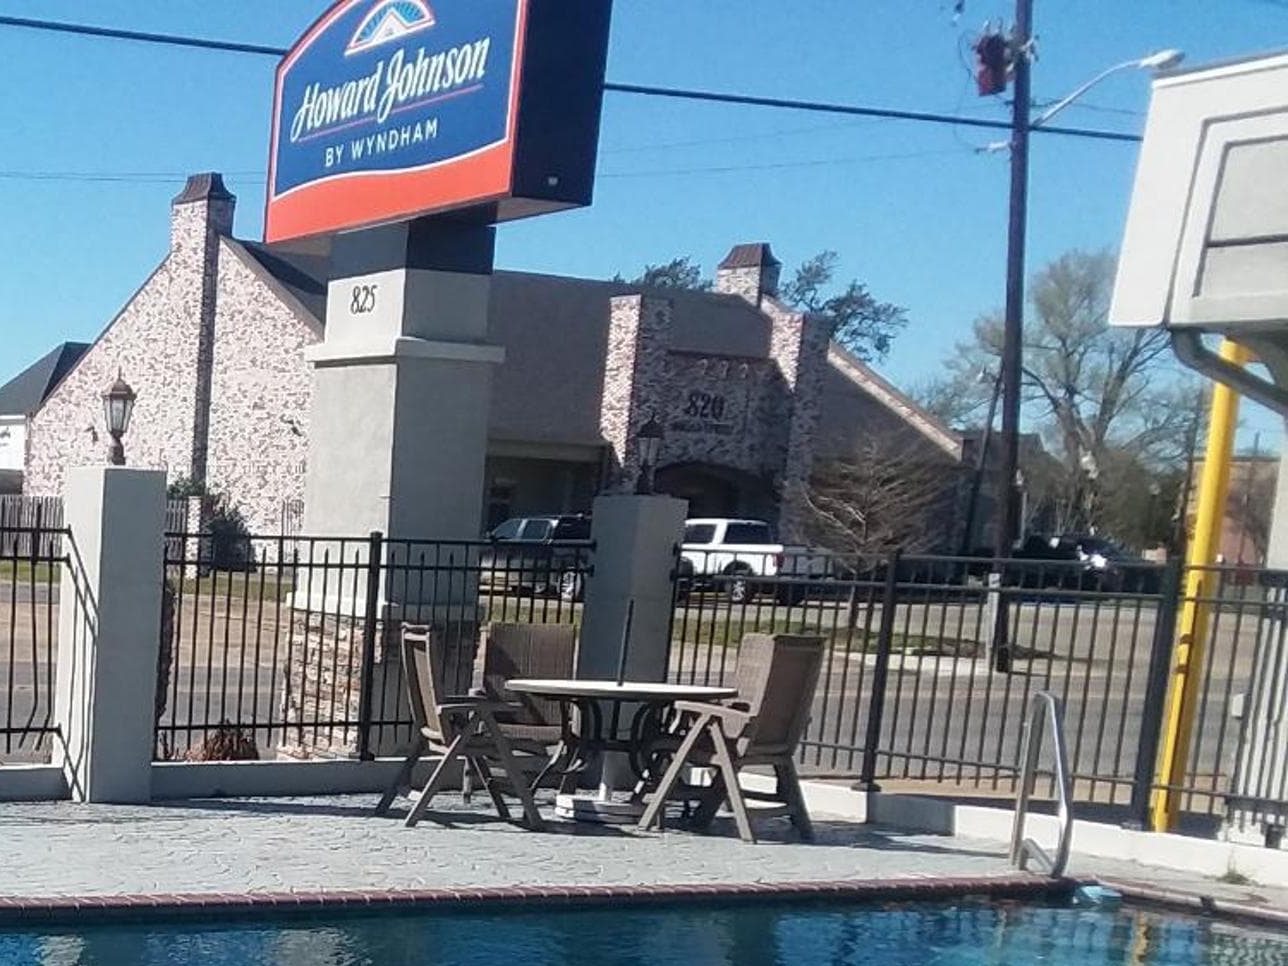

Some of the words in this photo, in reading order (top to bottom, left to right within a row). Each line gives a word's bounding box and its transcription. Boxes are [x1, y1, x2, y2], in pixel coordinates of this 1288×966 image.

[291, 61, 383, 143] Howard
[376, 37, 491, 122] Johnson
[324, 145, 343, 167] BY
[351, 118, 438, 160] WYNDHAM
[350, 285, 378, 314] 825
